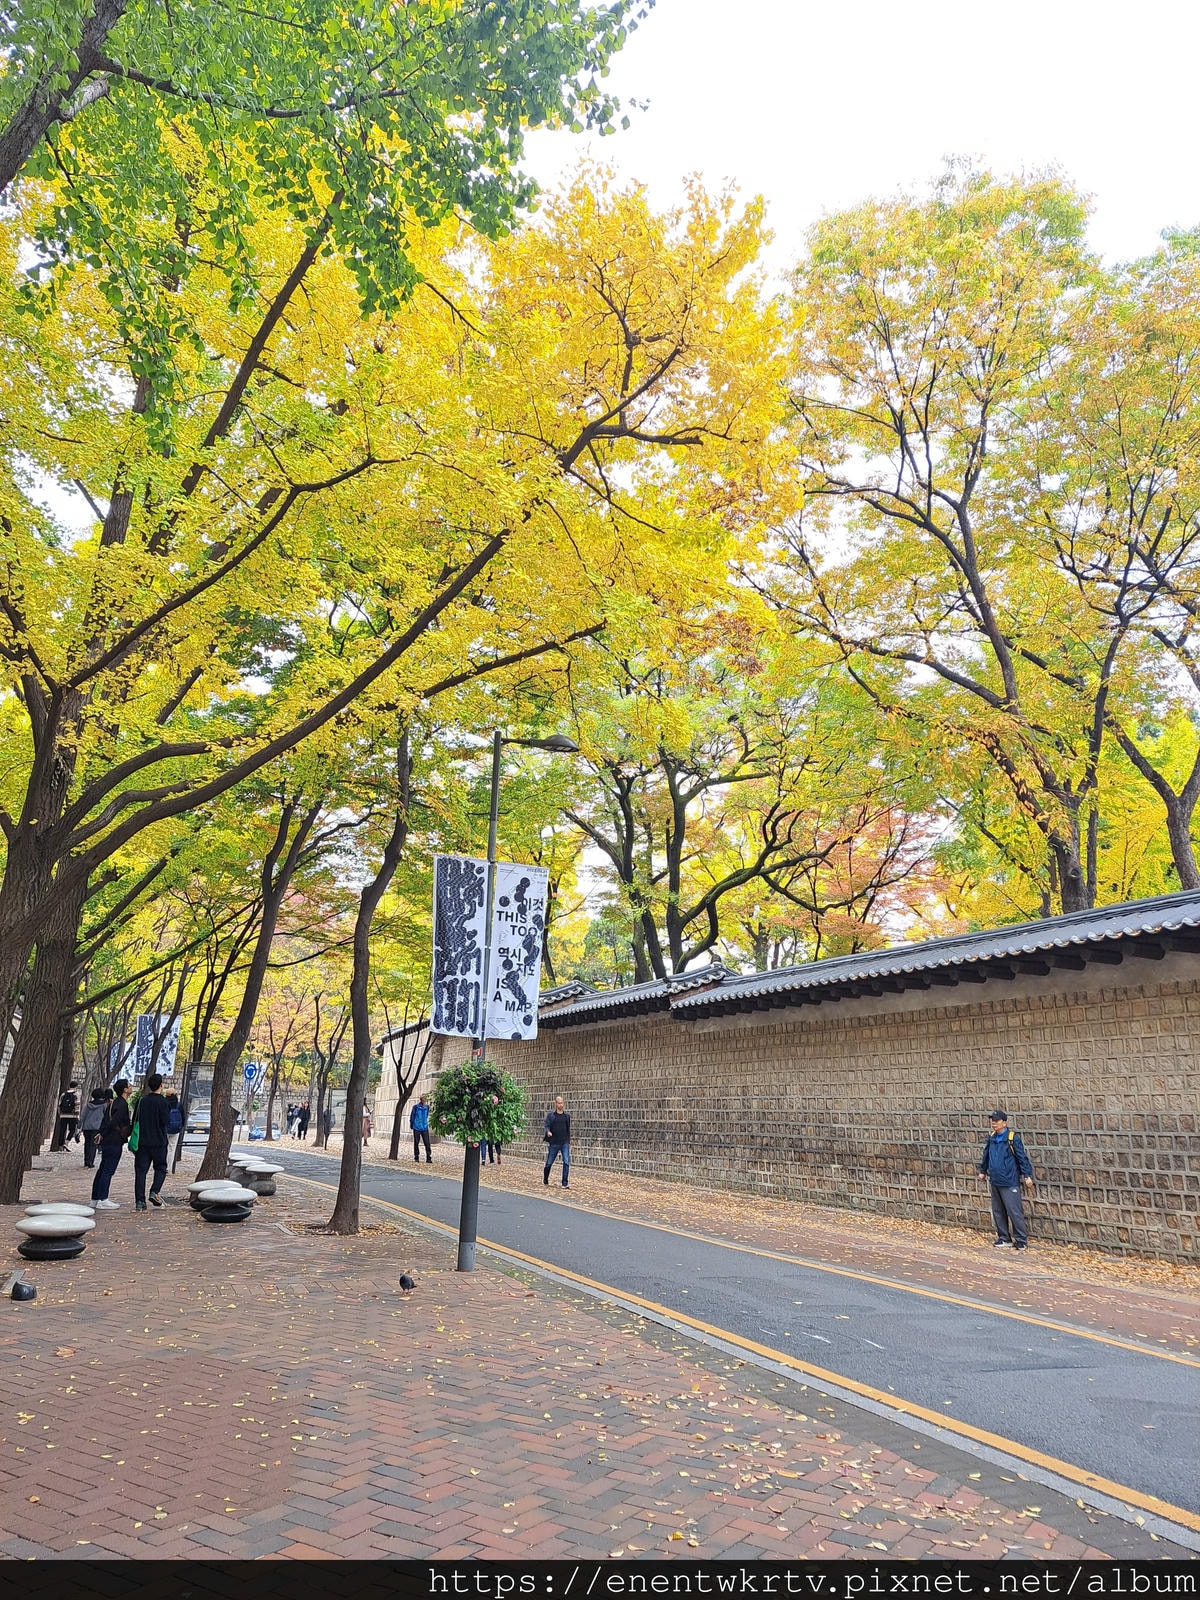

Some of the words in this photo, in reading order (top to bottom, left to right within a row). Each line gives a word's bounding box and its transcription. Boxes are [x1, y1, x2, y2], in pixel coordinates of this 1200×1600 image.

[496, 910, 527, 924] THIS
[510, 924, 538, 937] TOO
[498, 947, 521, 962] 역시
[496, 977, 511, 989] IS
[492, 990, 503, 1002] A
[504, 1000, 533, 1013] MAP
